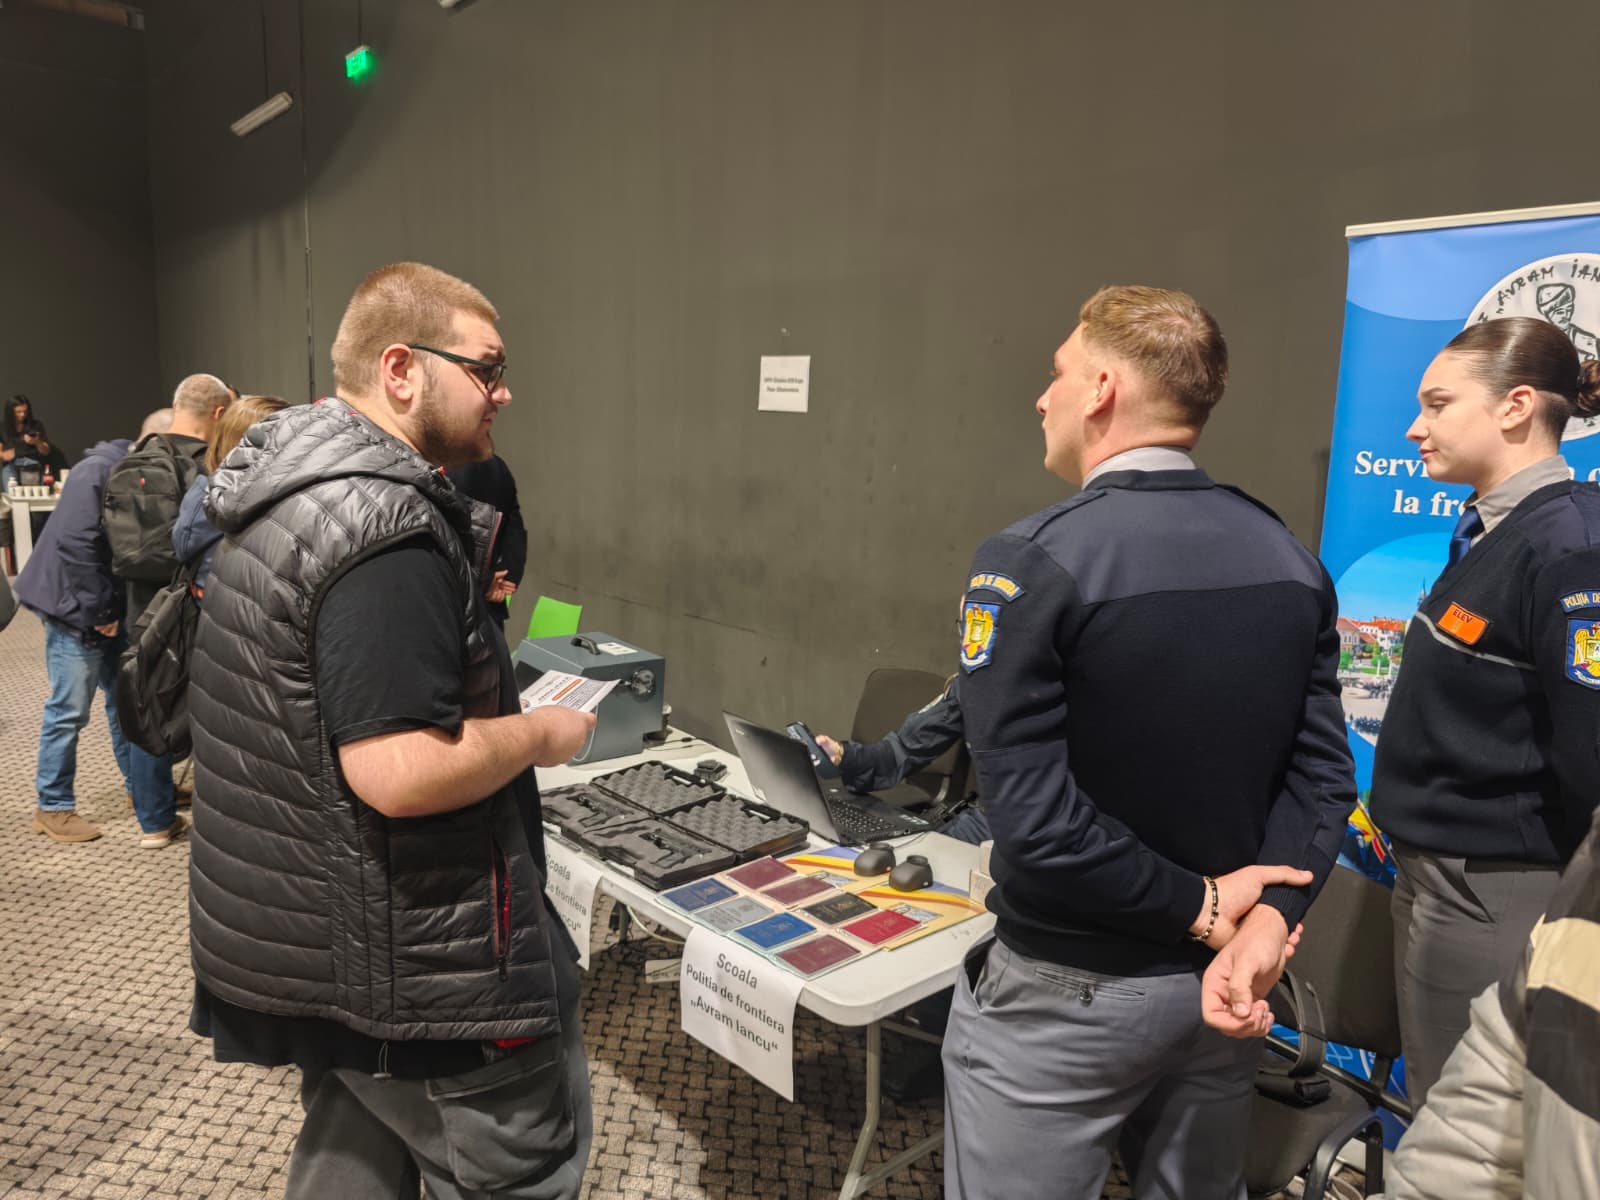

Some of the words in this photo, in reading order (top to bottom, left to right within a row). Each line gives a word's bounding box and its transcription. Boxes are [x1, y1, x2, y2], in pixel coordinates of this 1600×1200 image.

[1392, 489, 1420, 514] la
[1452, 609, 1473, 623] ELEV
[555, 886, 587, 916] frontiera
[716, 953, 758, 989] Scoala
[686, 963, 718, 993] Politia
[720, 986, 734, 1002] de
[736, 994, 785, 1034] frontiera
